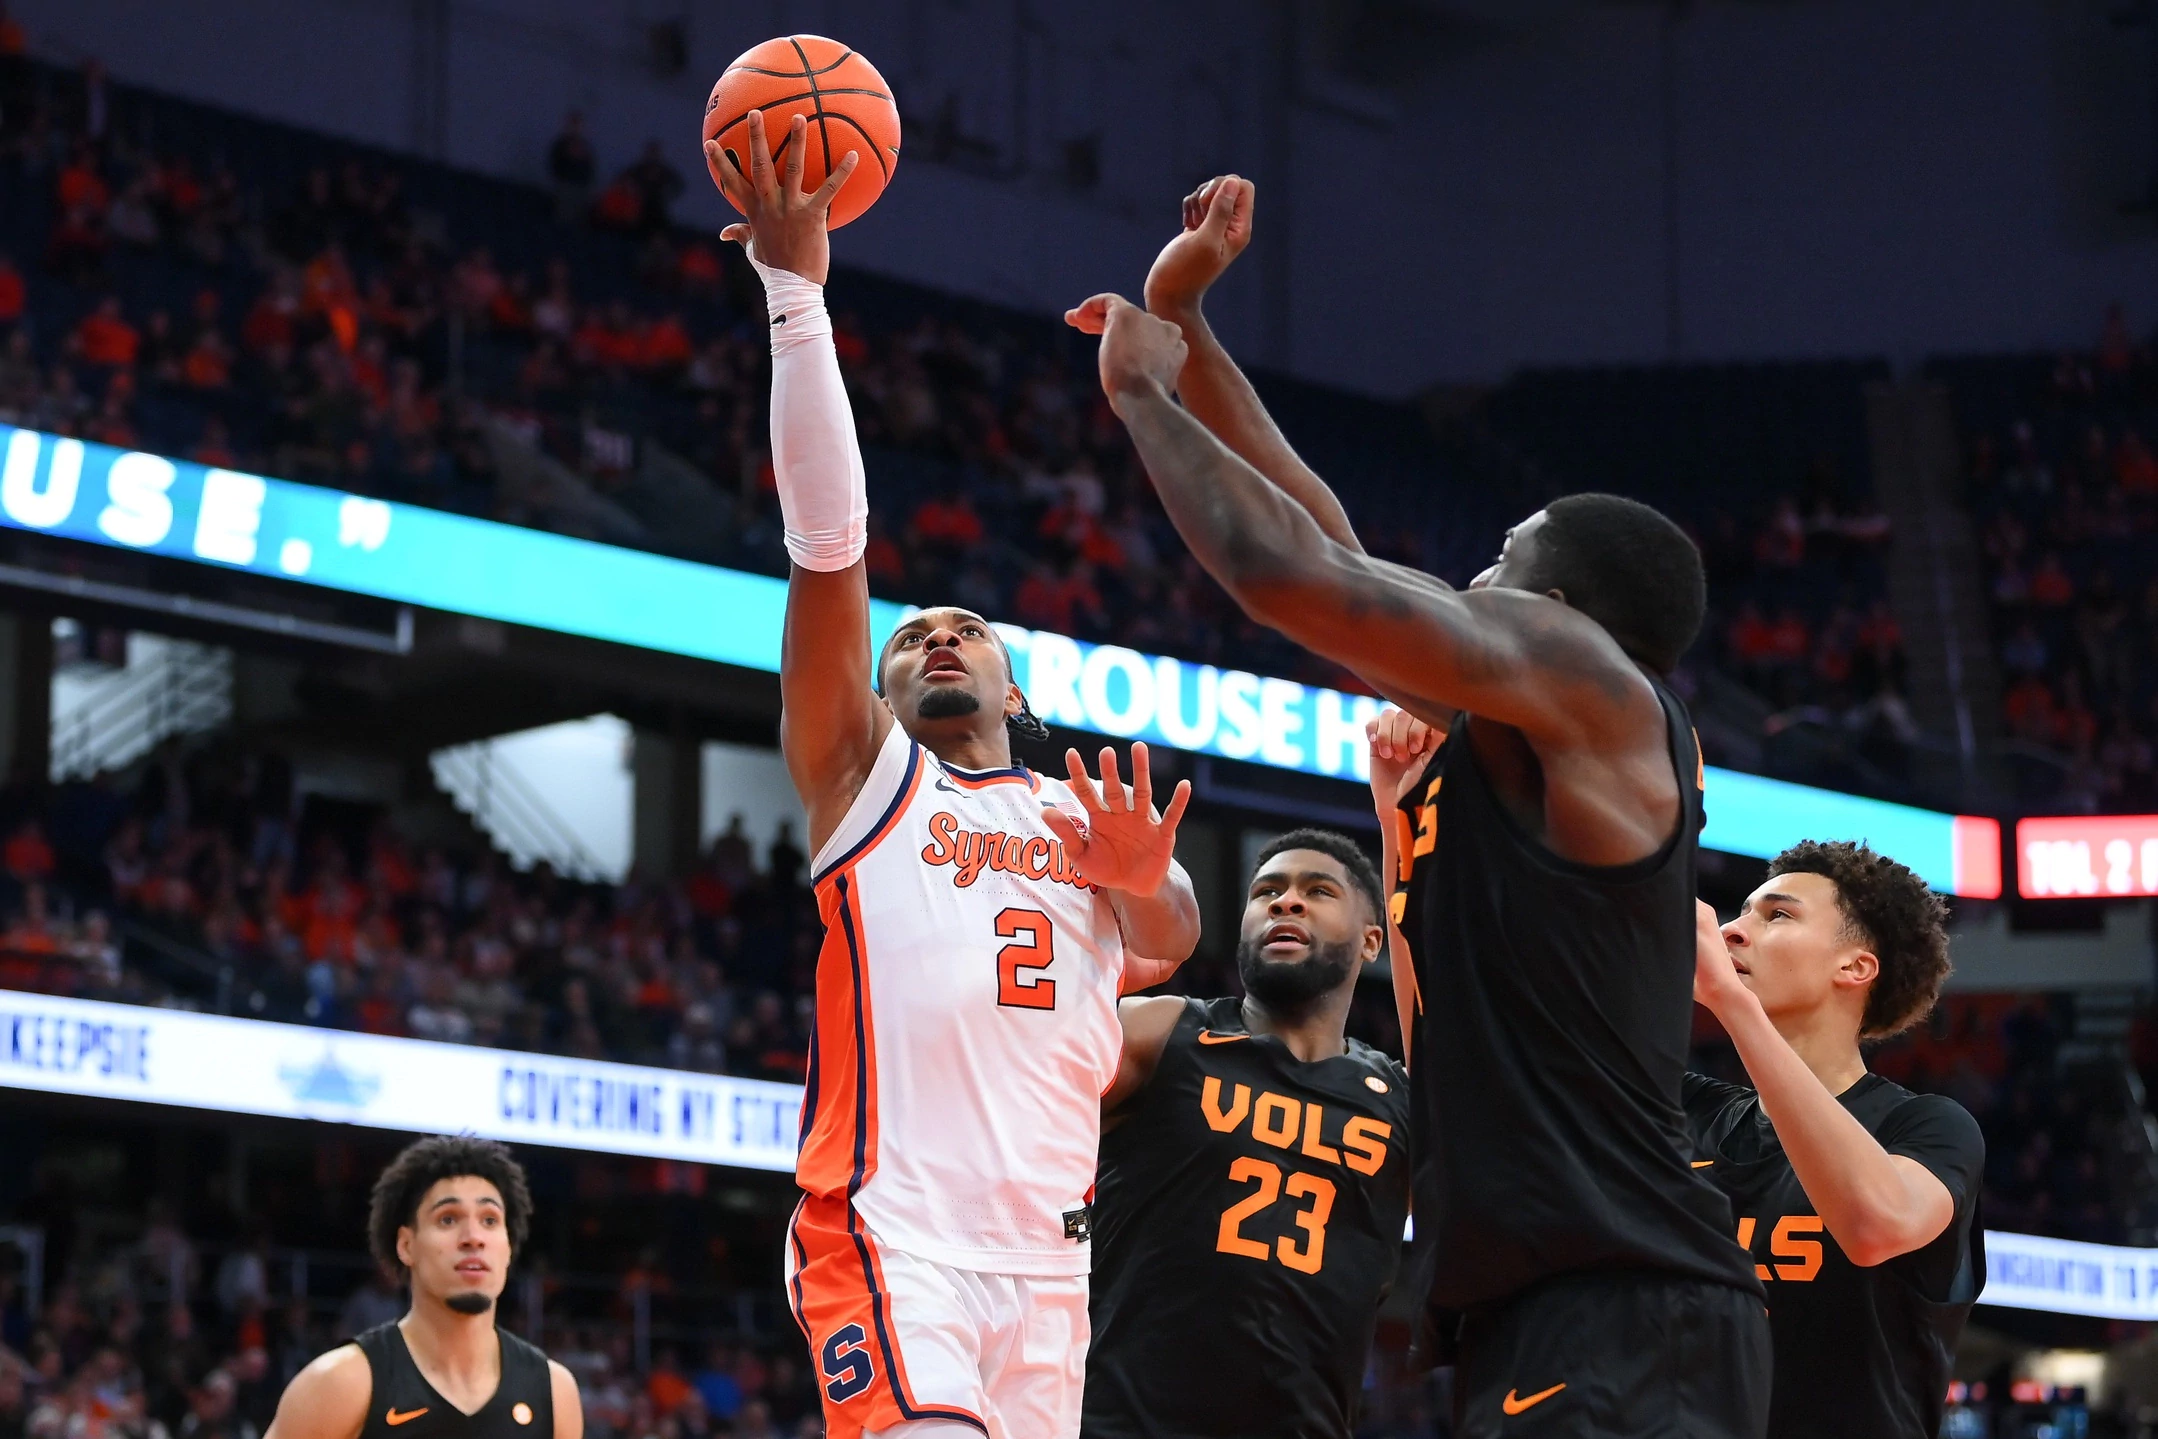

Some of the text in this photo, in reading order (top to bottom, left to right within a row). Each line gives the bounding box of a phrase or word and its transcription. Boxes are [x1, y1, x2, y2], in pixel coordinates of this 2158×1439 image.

[1316, 688, 1400, 782] H
[922, 811, 1098, 895] Syracu
[994, 907, 1056, 1011] 2
[1200, 1075, 1392, 1177] VOLS
[1216, 1156, 1337, 1275] 23
[821, 1322, 875, 1404] S
